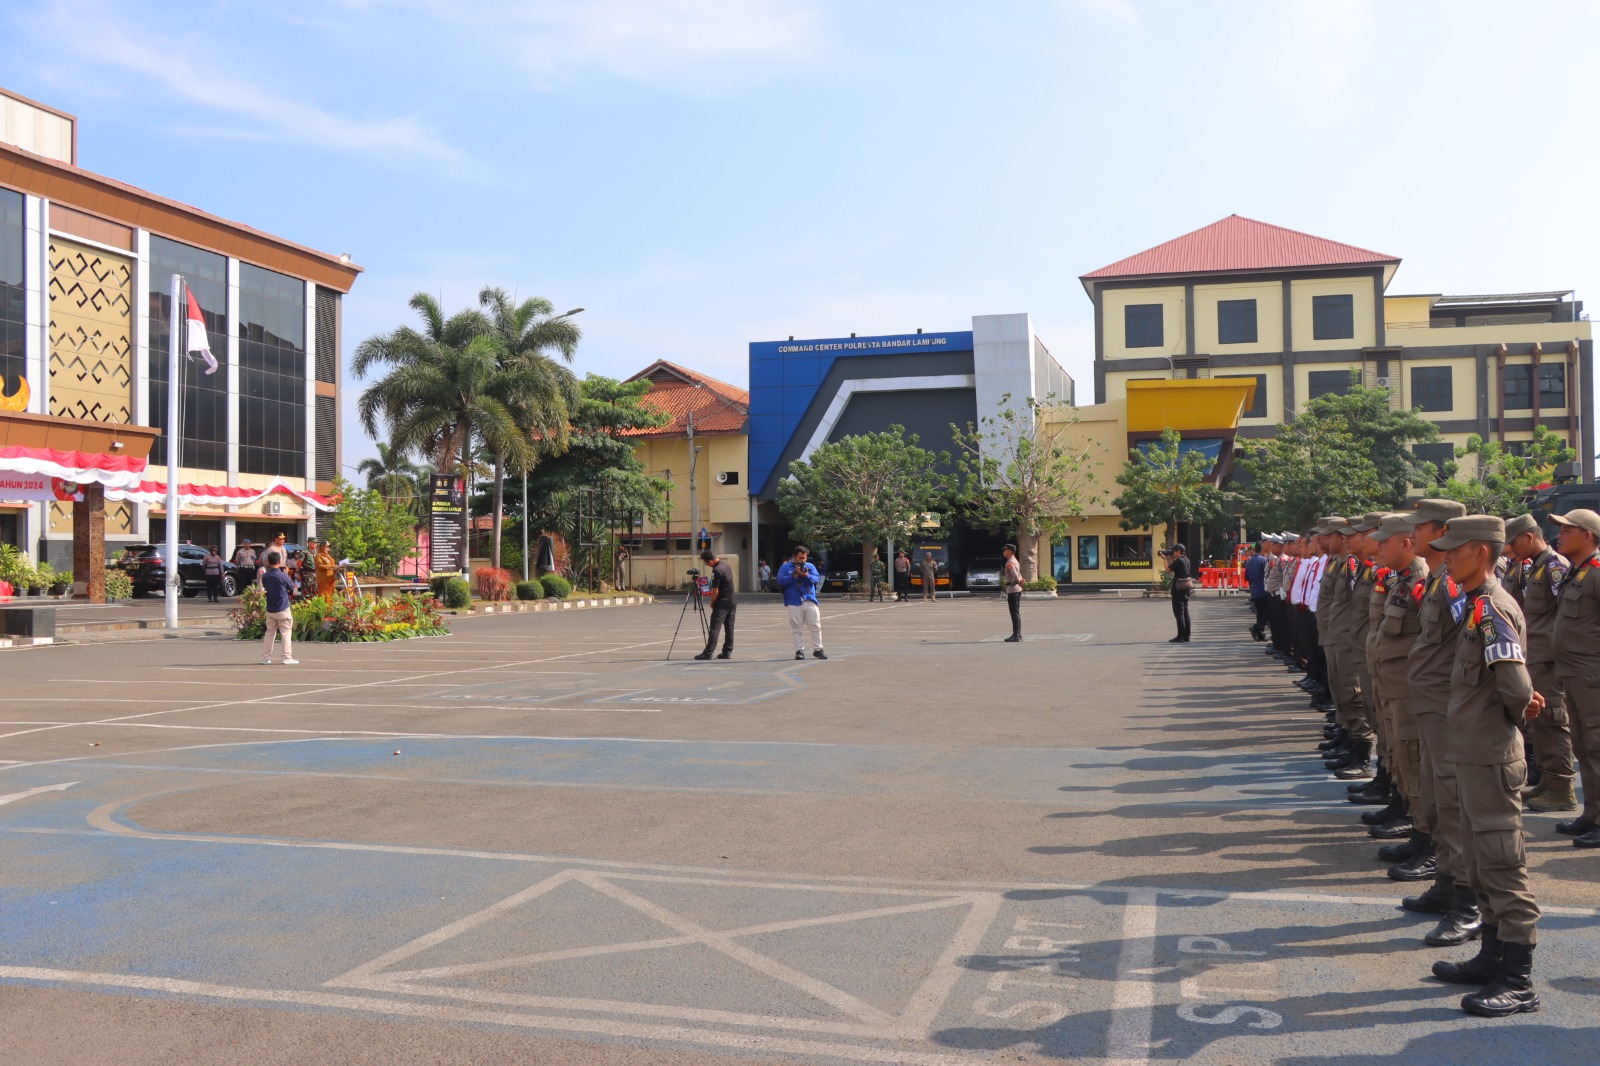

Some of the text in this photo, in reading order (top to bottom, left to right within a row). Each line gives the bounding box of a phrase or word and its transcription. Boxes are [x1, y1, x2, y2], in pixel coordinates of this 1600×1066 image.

[778, 345, 814, 353] COMMAND
[844, 342, 881, 350] POLRESTA
[912, 338, 947, 346] LAMPUNG
[0, 480, 44, 490] AHUN 2024
[1450, 597, 1466, 624] AT
[1484, 642, 1525, 663] TUR
